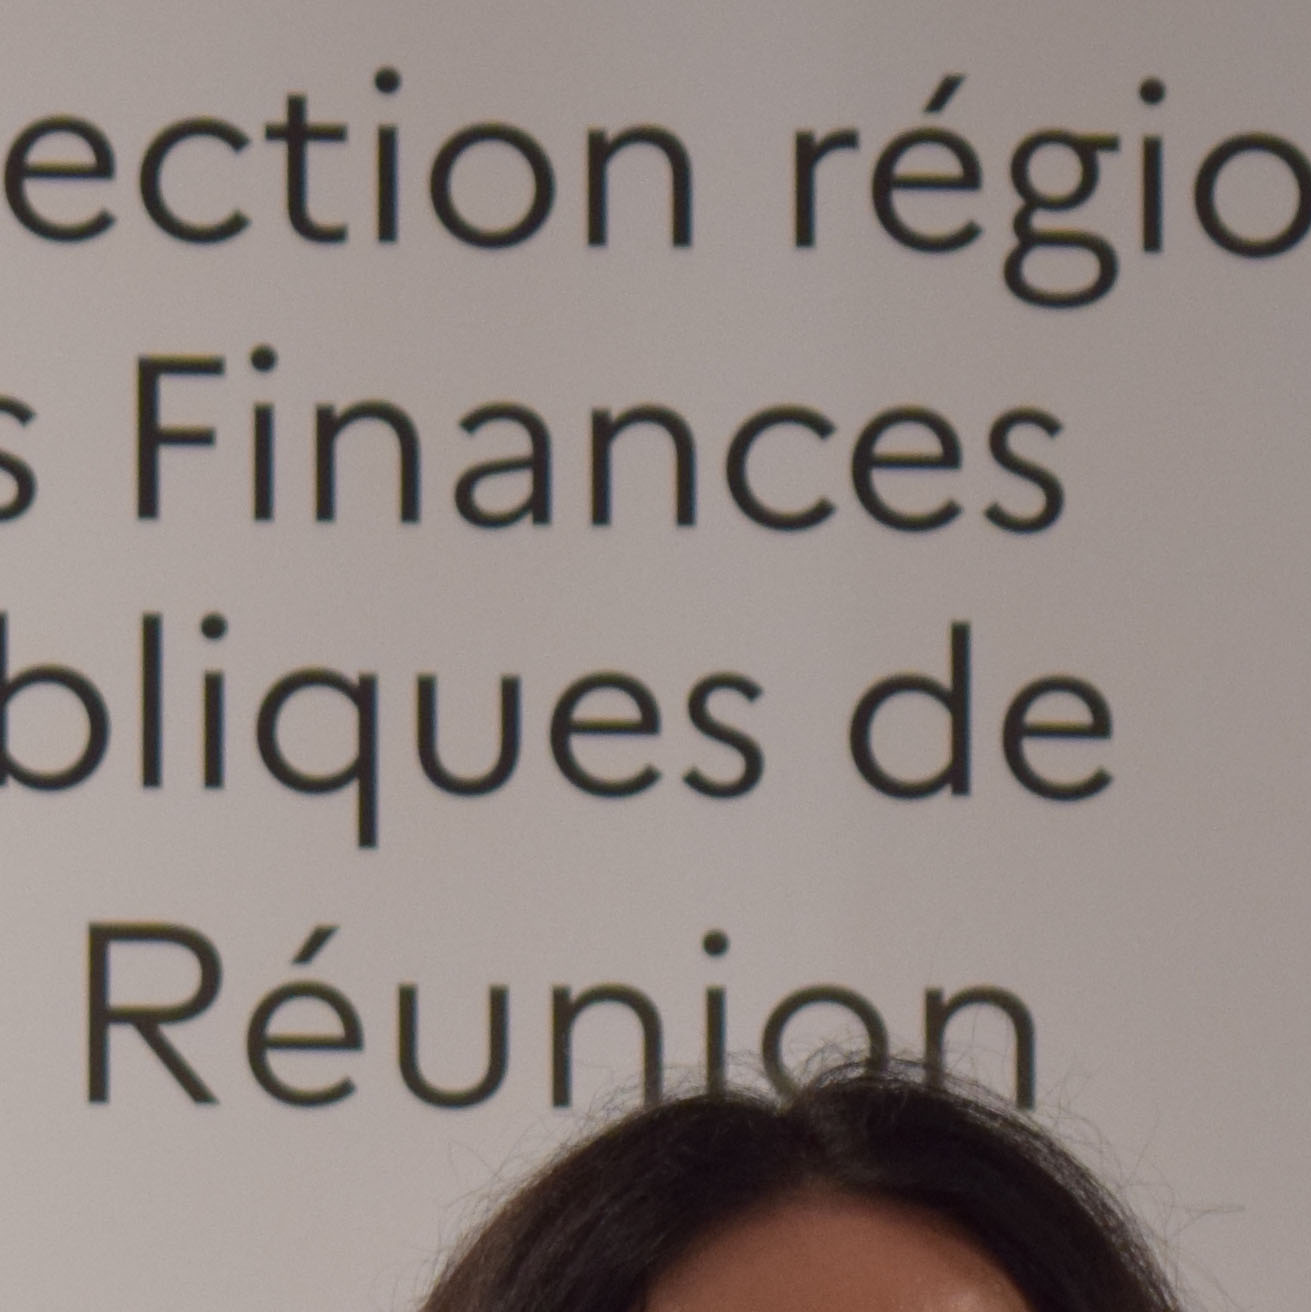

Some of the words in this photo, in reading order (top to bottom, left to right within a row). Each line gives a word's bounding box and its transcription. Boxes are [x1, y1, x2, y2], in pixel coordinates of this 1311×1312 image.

[136, 345, 1066, 536] Finances
[848, 621, 1114, 803] de
[86, 921, 1036, 1112] Réunion
